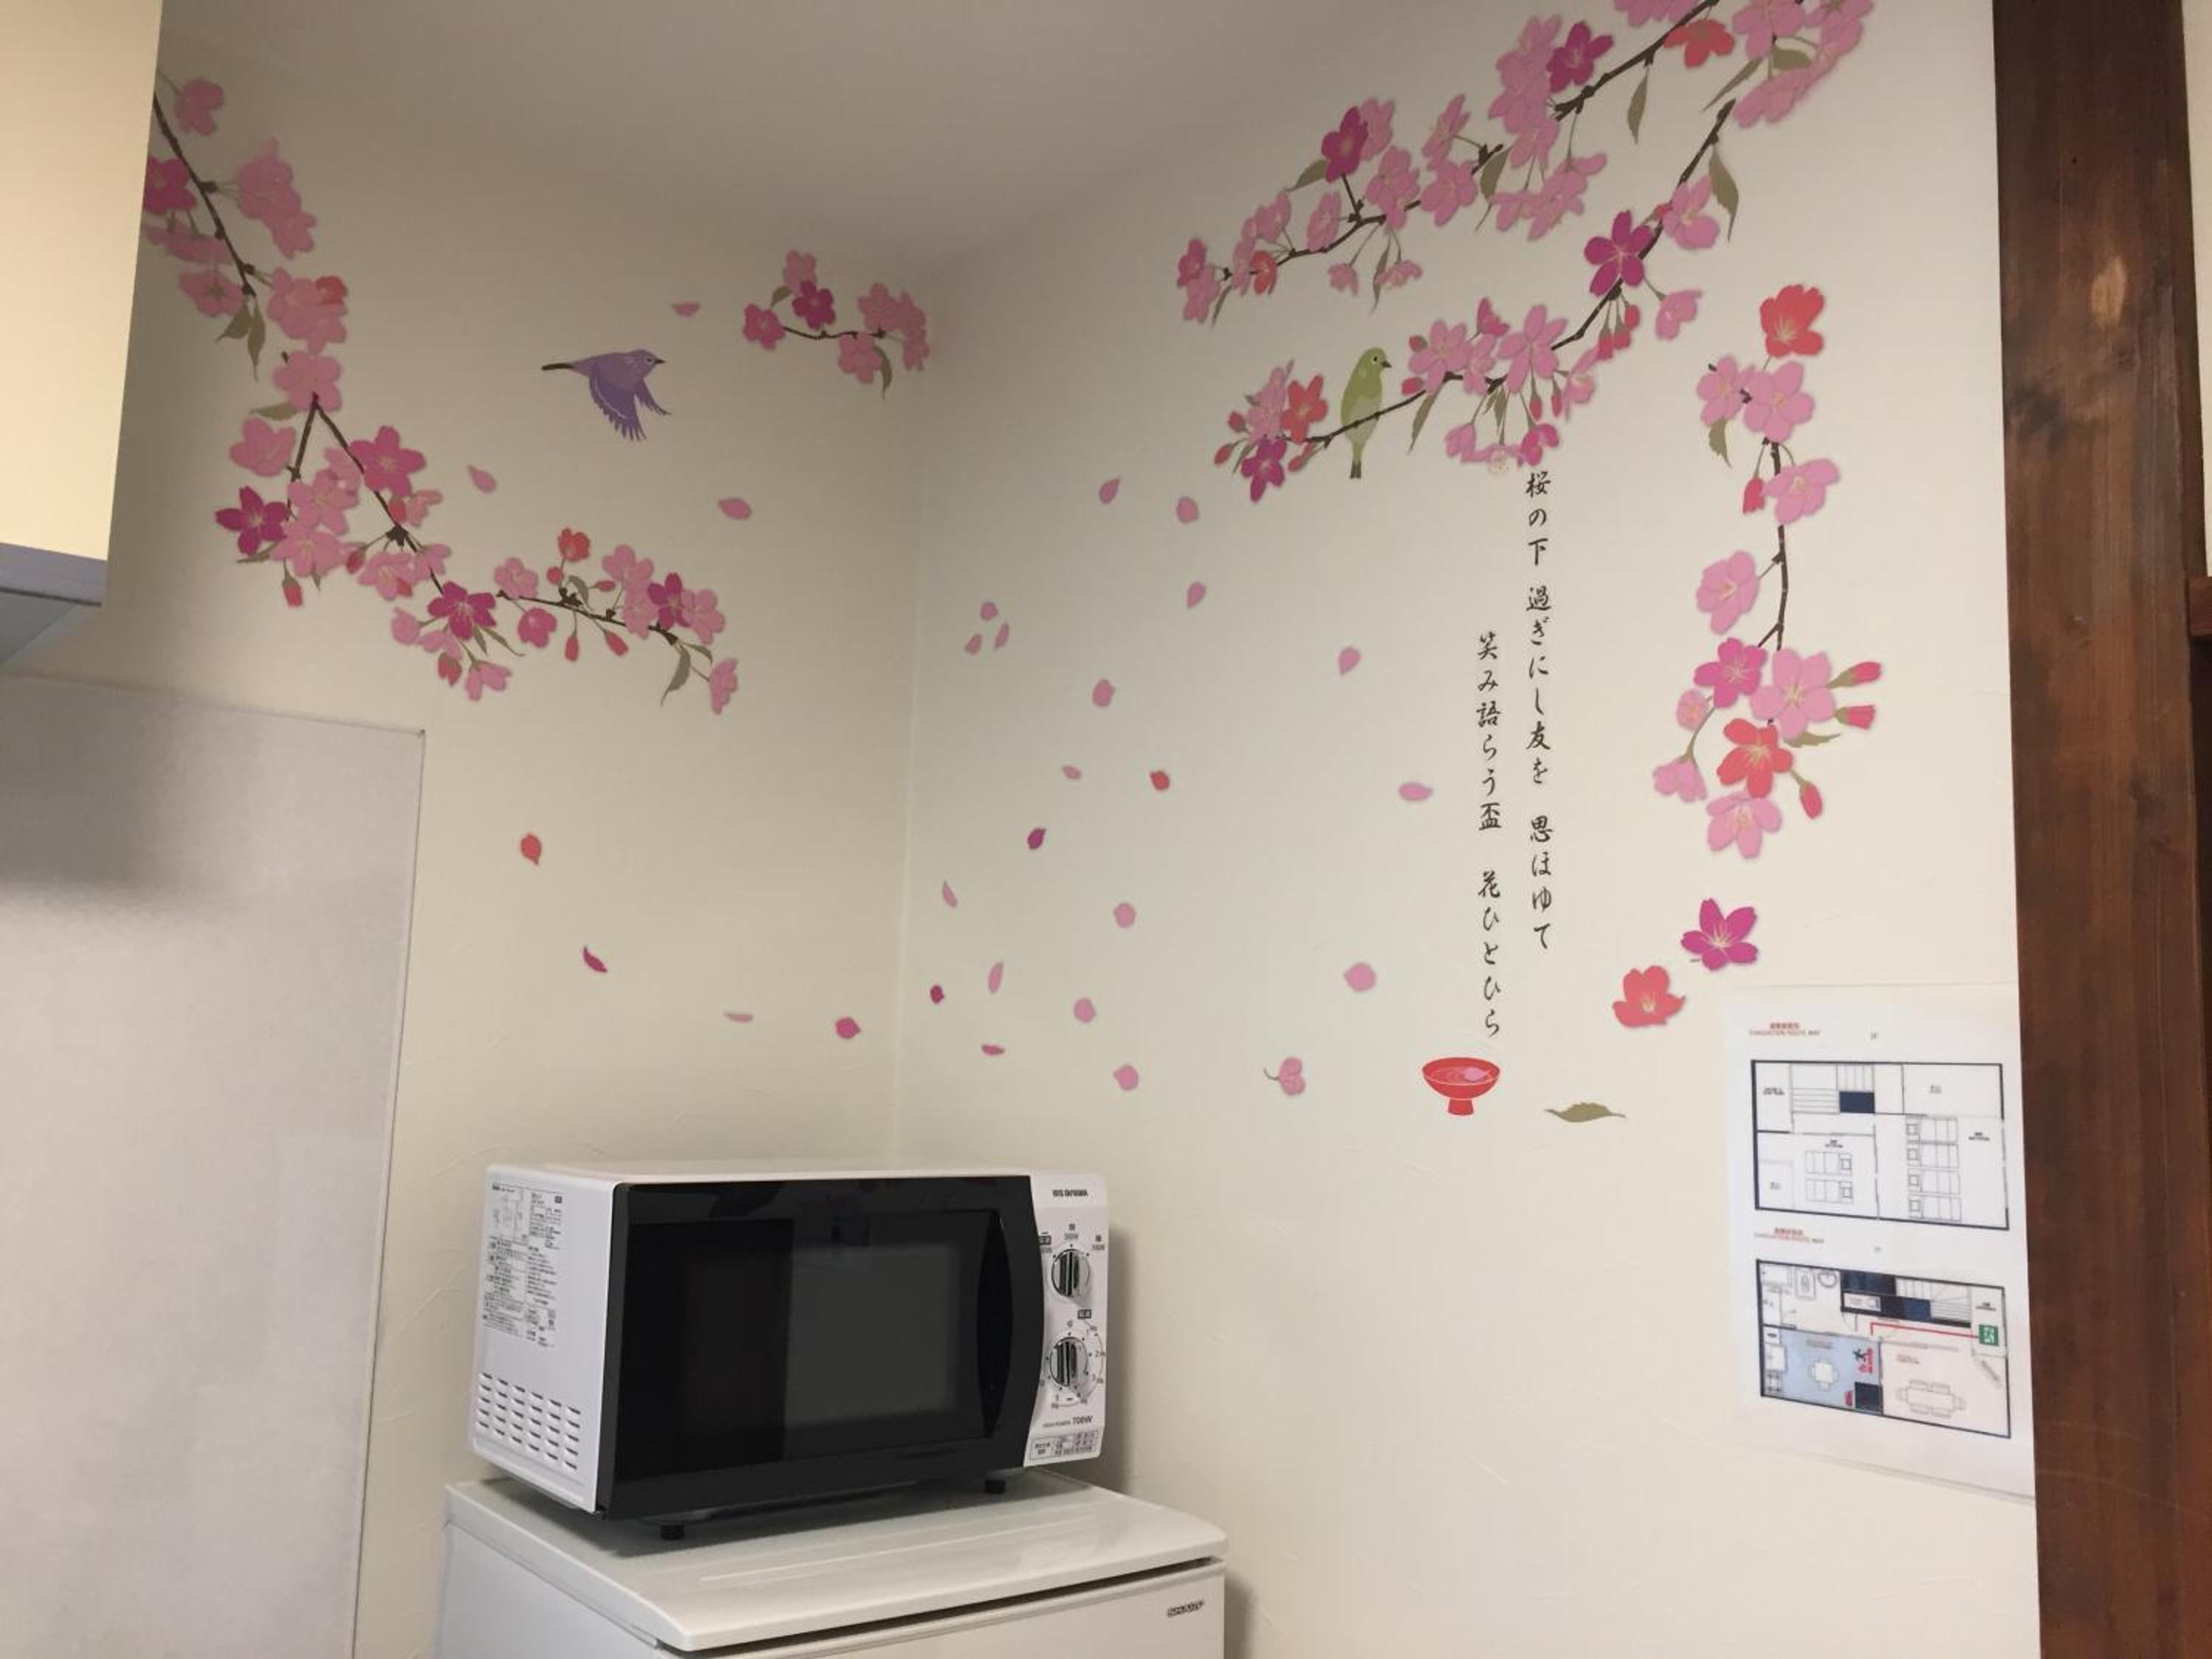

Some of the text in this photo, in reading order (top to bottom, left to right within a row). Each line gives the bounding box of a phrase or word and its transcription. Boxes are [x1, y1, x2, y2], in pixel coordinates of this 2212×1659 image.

[1525, 470, 1551, 567] 桜の下
[1475, 630, 1503, 1037] 笑み語らう盃 花ひとひら
[1529, 814, 1554, 950] 思ほゆて
